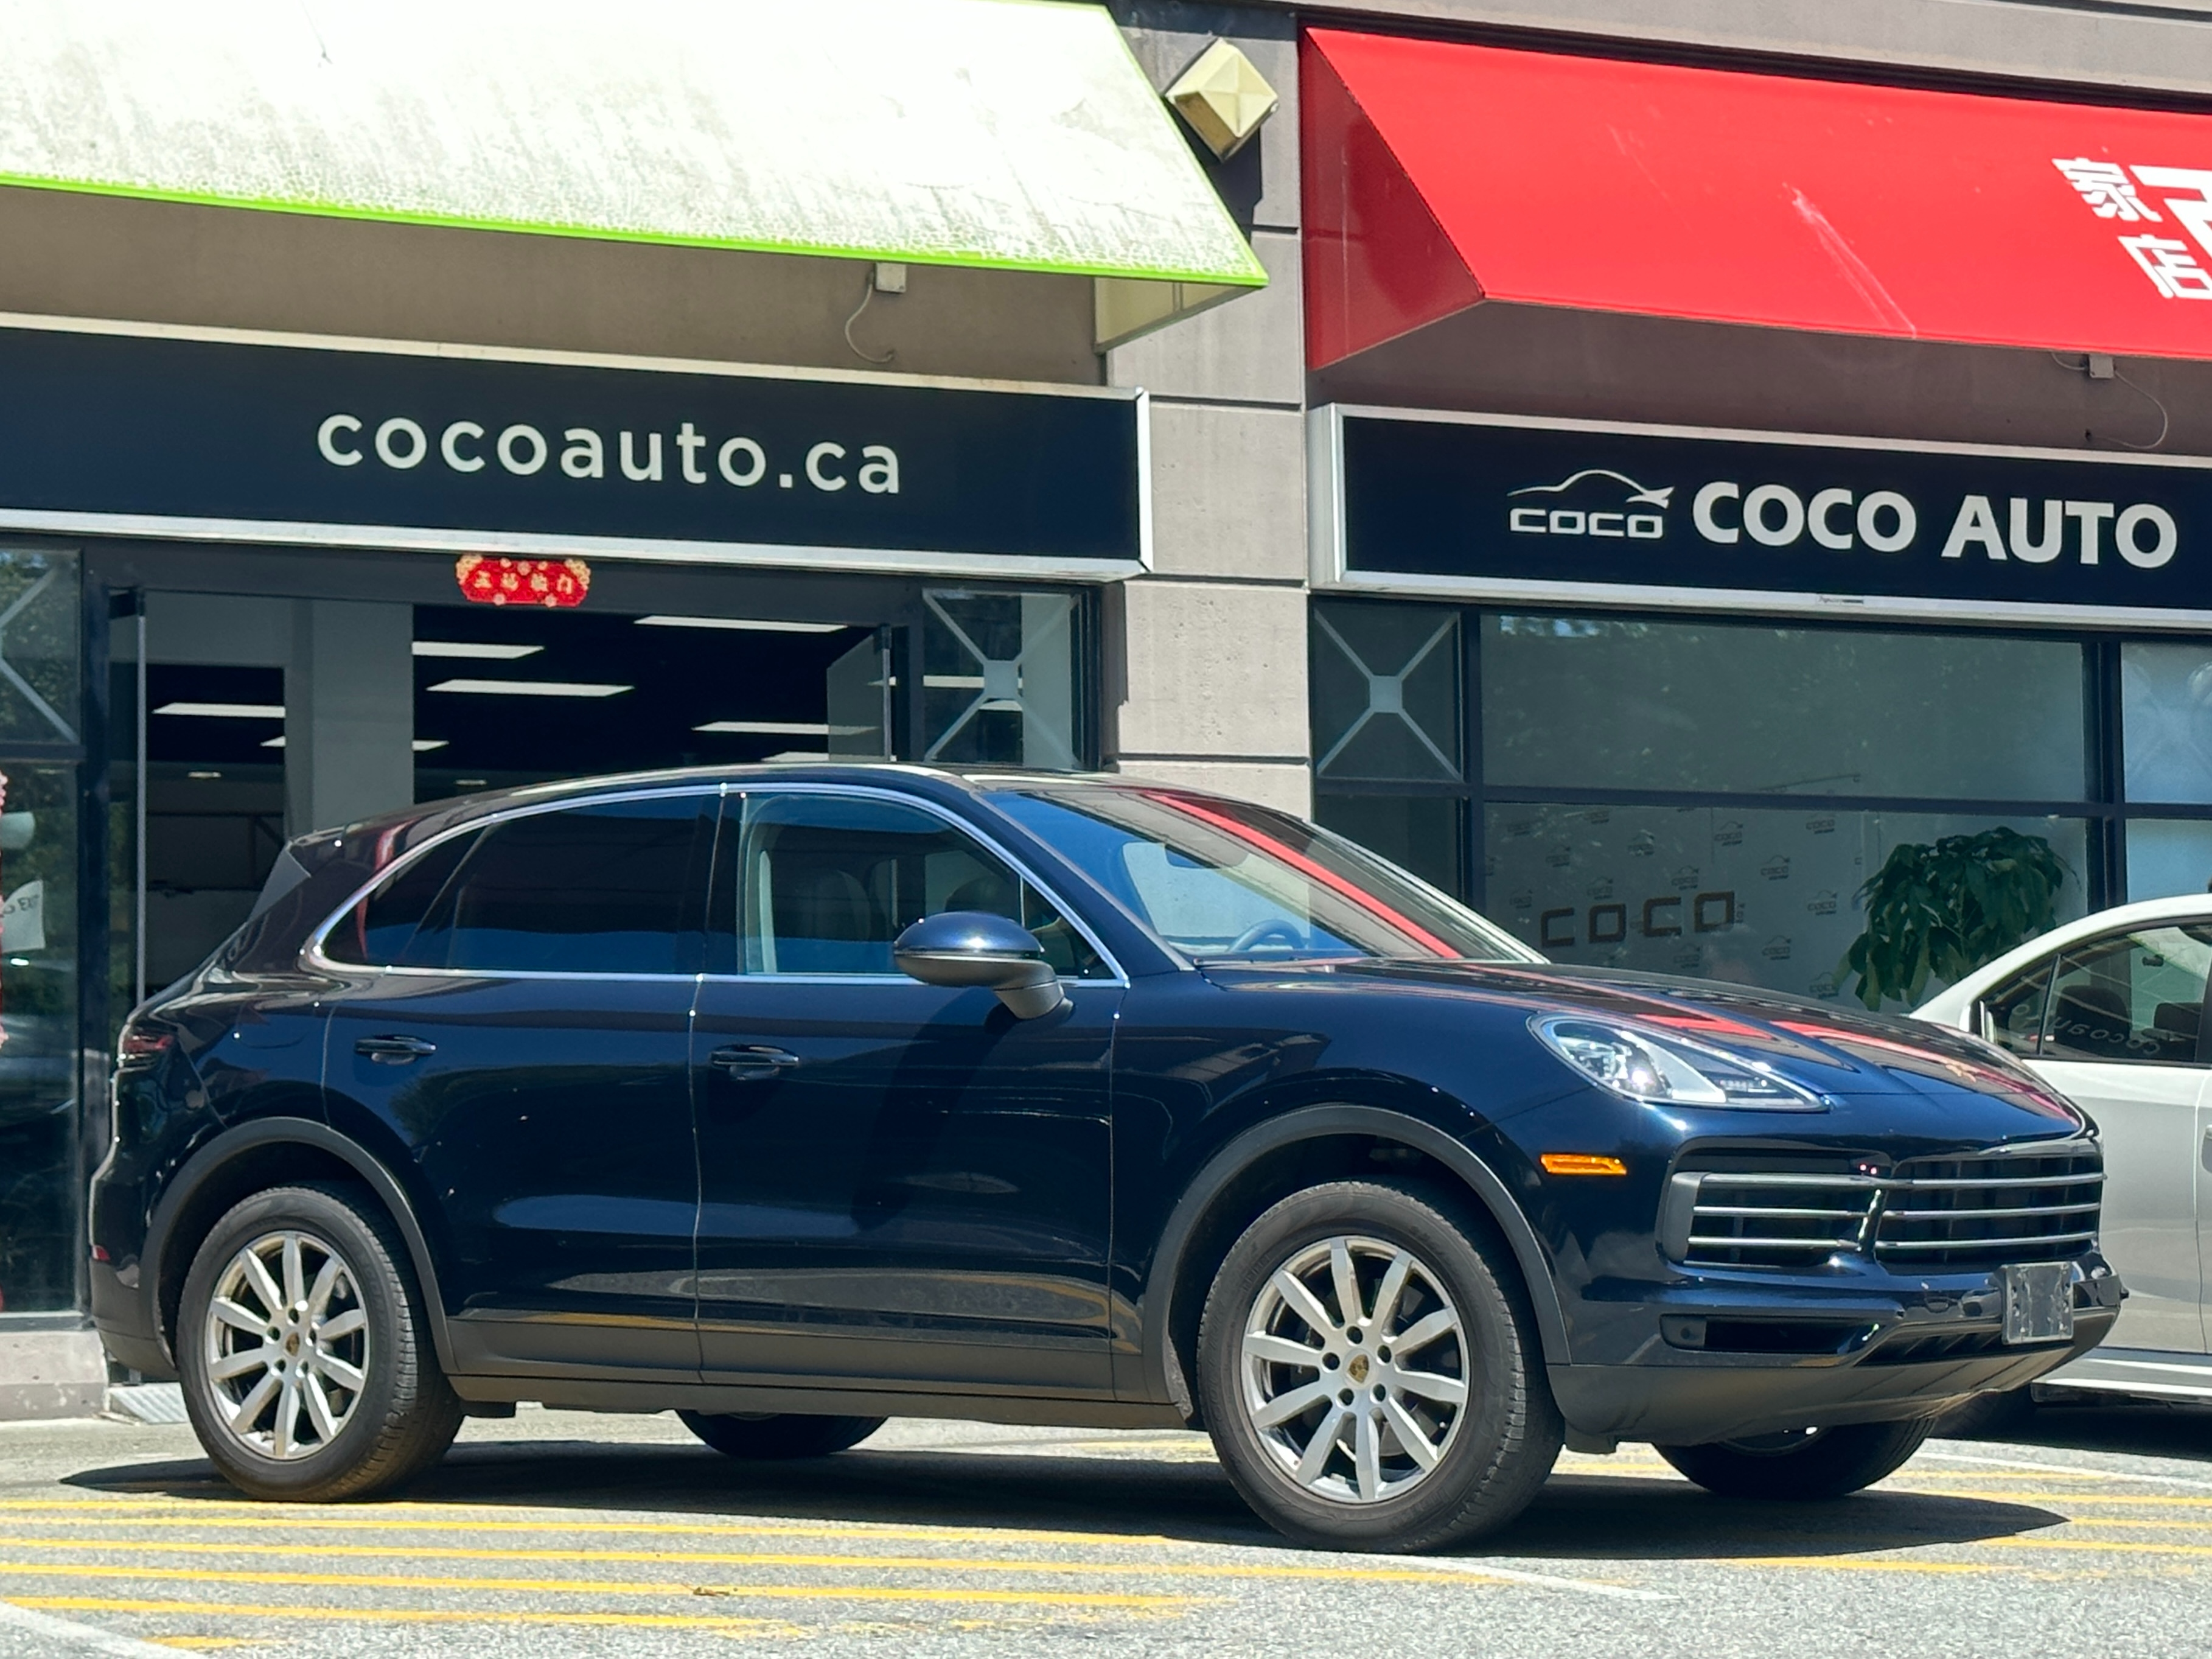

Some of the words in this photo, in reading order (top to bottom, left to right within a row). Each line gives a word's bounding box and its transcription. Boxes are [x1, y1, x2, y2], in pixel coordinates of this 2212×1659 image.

[318, 414, 899, 494] cocoauto.ca
[1510, 508, 1663, 539] COCO
[1692, 481, 1917, 553] COCO
[1941, 495, 2178, 569] AUTO
[1540, 890, 1735, 948] COCO
